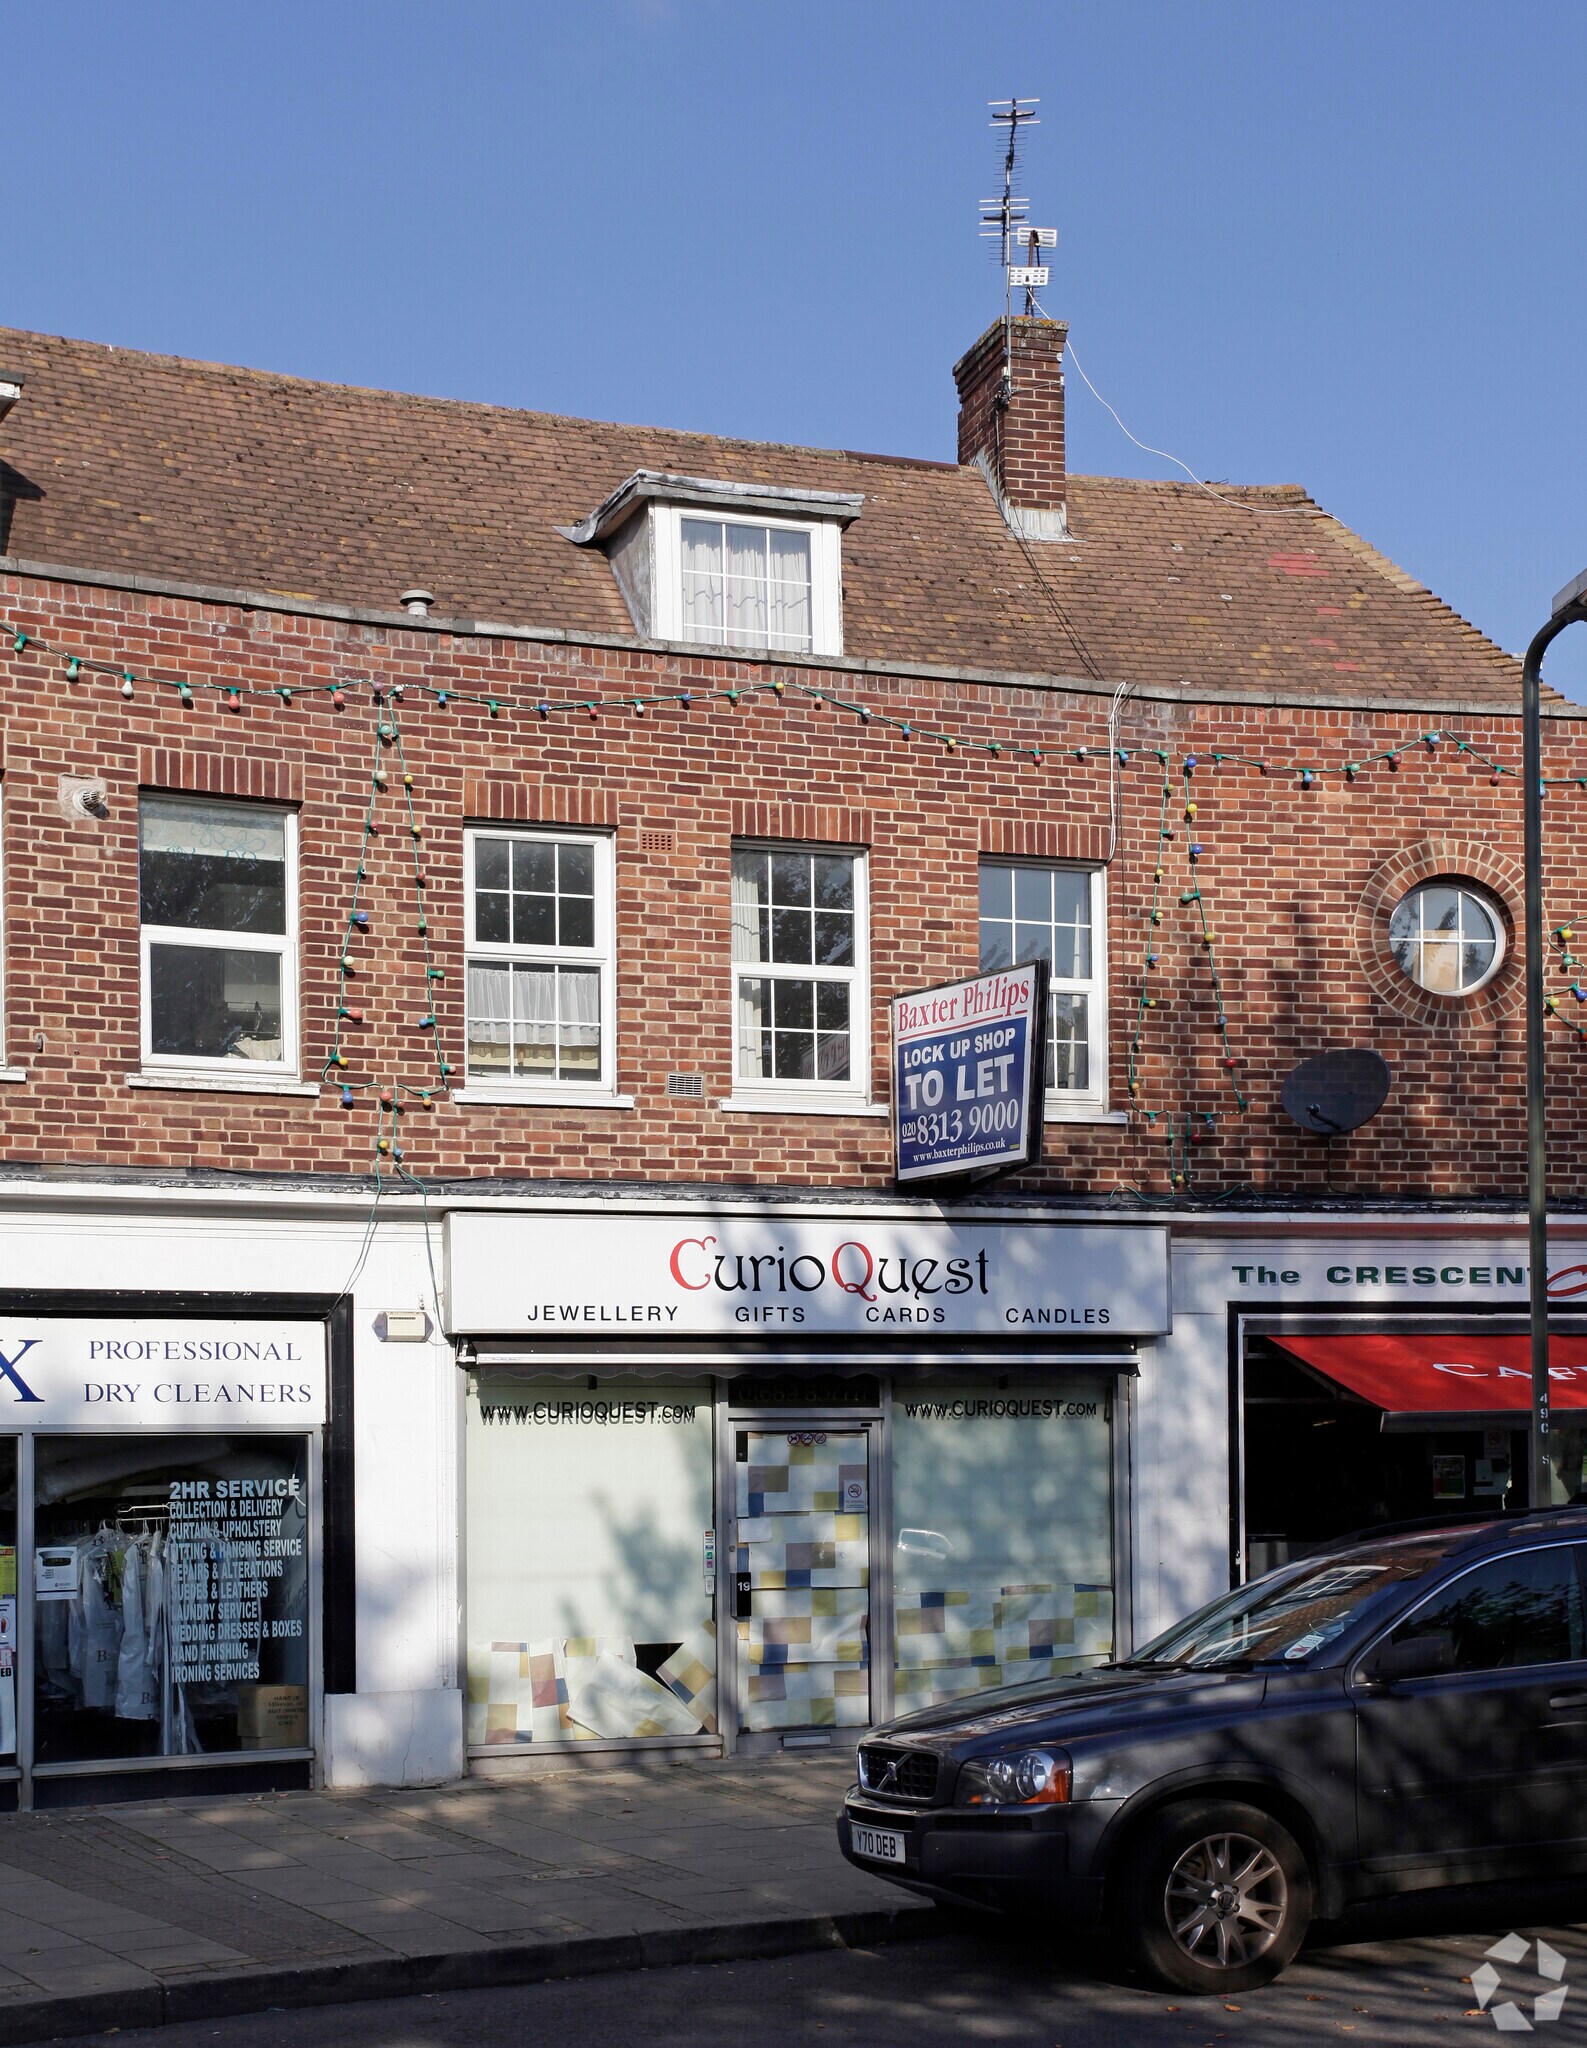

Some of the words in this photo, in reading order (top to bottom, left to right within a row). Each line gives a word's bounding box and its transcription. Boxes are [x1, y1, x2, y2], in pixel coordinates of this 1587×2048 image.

[898, 996, 958, 1032] Baxter
[962, 976, 1029, 1017] Philips
[904, 1043, 945, 1069] LOCK
[949, 1038, 971, 1060] UP
[974, 1027, 1016, 1054] SHOP
[904, 1070, 944, 1110] TO
[956, 1053, 1015, 1101] LET
[902, 1121, 916, 1138] 020
[917, 1109, 963, 1146] 8313
[968, 1098, 1019, 1141] 9000
[912, 1137, 1006, 1163] www.baxterphilips.co.uk
[1231, 1265, 1300, 1285] The
[1325, 1265, 1548, 1285] CRESCEN
[527, 1305, 679, 1321] JEWELLERY
[735, 1306, 806, 1322] GIFTS
[866, 1306, 946, 1323] CARDS
[1005, 1308, 1110, 1324] CANDLES
[88, 1340, 302, 1361] PROFESSIONAL
[1432, 1362, 1587, 1381] CAF
[83, 1383, 142, 1403] DRY
[153, 1383, 312, 1403] CLEANERS
[215, 1478, 300, 1498] SERVICE
[169, 1500, 228, 1519] COLLECTION
[230, 1500, 237, 1517] &
[239, 1499, 284, 1517] DELIVERY
[213, 1521, 220, 1538] &
[222, 1519, 282, 1538] UPHOLSTERY
[209, 1542, 216, 1559] &
[219, 1540, 262, 1560] HANGING
[263, 1538, 302, 1557] SERVICE
[171, 1562, 210, 1581] REPAIRS
[212, 1563, 218, 1580] &
[221, 1560, 284, 1579] ALTERATIONS
[171, 1582, 208, 1601] SUEDES
[211, 1582, 218, 1600] &
[220, 1581, 269, 1599] LEATHERS
[737, 1581, 751, 1592] 19
[171, 1603, 215, 1621] LAUNDRY
[217, 1601, 258, 1619] SERVICE
[171, 1623, 215, 1642] WEDDING
[217, 1621, 260, 1640] DRESSES
[262, 1621, 269, 1638] &
[271, 1619, 302, 1638] BOXES
[171, 1644, 199, 1662] HAND
[200, 1642, 249, 1661] FINISHING
[171, 1663, 212, 1683] IRONING
[214, 1661, 260, 1681] SERVICES
[857, 1830, 874, 1853] Y70
[876, 1833, 896, 1857] DEB
